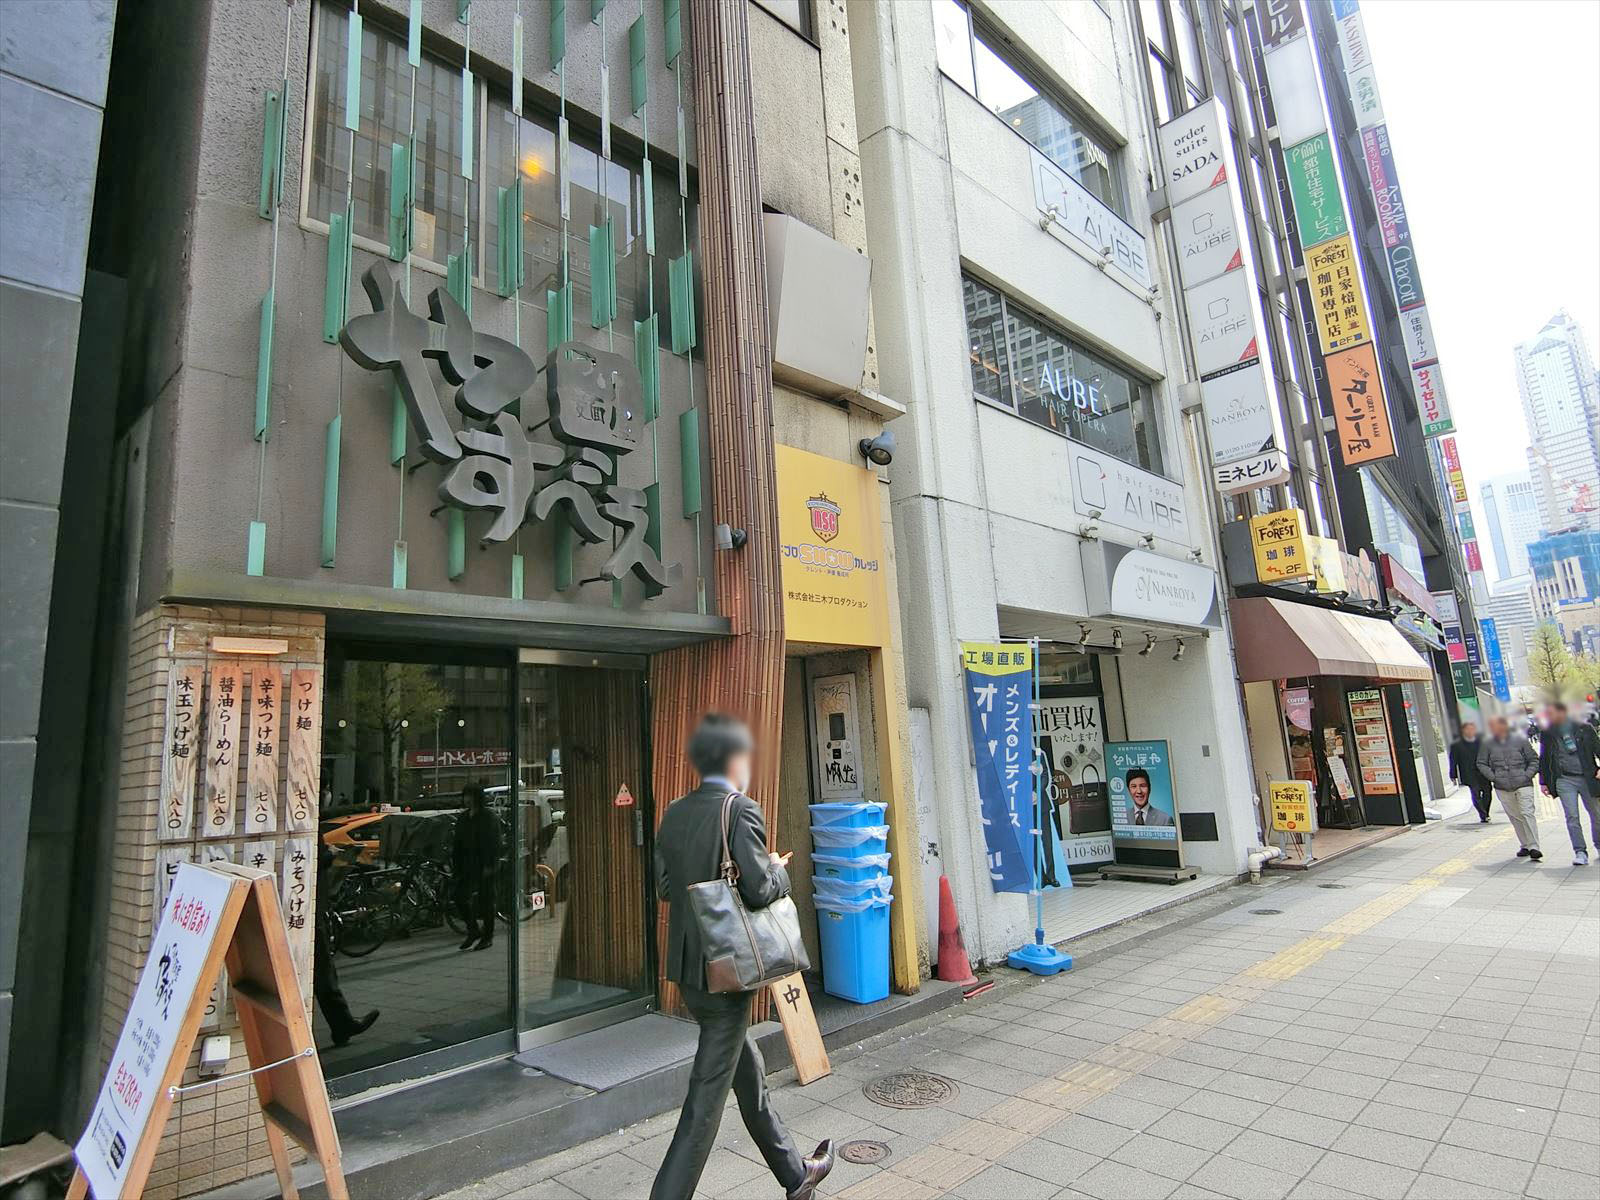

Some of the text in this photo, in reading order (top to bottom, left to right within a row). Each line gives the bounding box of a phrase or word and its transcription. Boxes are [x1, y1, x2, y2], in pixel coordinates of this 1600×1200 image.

[1174, 125, 1206, 147] order
[1176, 136, 1208, 158] suits
[1172, 151, 1219, 182] SADA
[1303, 157, 1332, 240] 都市住宅サービス
[1377, 187, 1396, 229] ROOMS
[1084, 216, 1145, 279] AUBE
[1185, 231, 1231, 258] AUBE
[1313, 249, 1346, 267] FOREST
[1392, 246, 1418, 303] Chacott
[1336, 266, 1358, 319] 自家焙煎
[1200, 318, 1247, 344] AUBE
[1339, 335, 1353, 346] 2F
[1040, 362, 1102, 416] AUBE
[1417, 370, 1439, 422] サイゼリヤ
[1040, 394, 1107, 434] HAIR OPERA
[1211, 404, 1265, 426] NANBOYA
[1341, 378, 1371, 455] ターリー屋
[1117, 471, 1142, 489] hair
[1218, 458, 1278, 484] ミネビル
[1124, 491, 1183, 531] AUBE
[1258, 525, 1294, 541] FOREST
[780, 544, 799, 559] プロ
[853, 556, 879, 572] カレッジ
[1286, 563, 1301, 574] 2F
[788, 591, 868, 609] 株式会社三木プロダクション
[1152, 578, 1197, 602] NANBOYA
[966, 650, 1025, 667] 工場直販
[171, 677, 194, 758] 味玉つけ麺
[255, 679, 274, 757] 辛味つけ麺
[296, 681, 312, 730] つけ麺
[1112, 752, 1161, 767] なんぼや
[1274, 791, 1303, 801] FOREST
[288, 850, 306, 931] みそつけ麺
[171, 893, 211, 938] 味に自信あり
[783, 984, 801, 1013] 中
